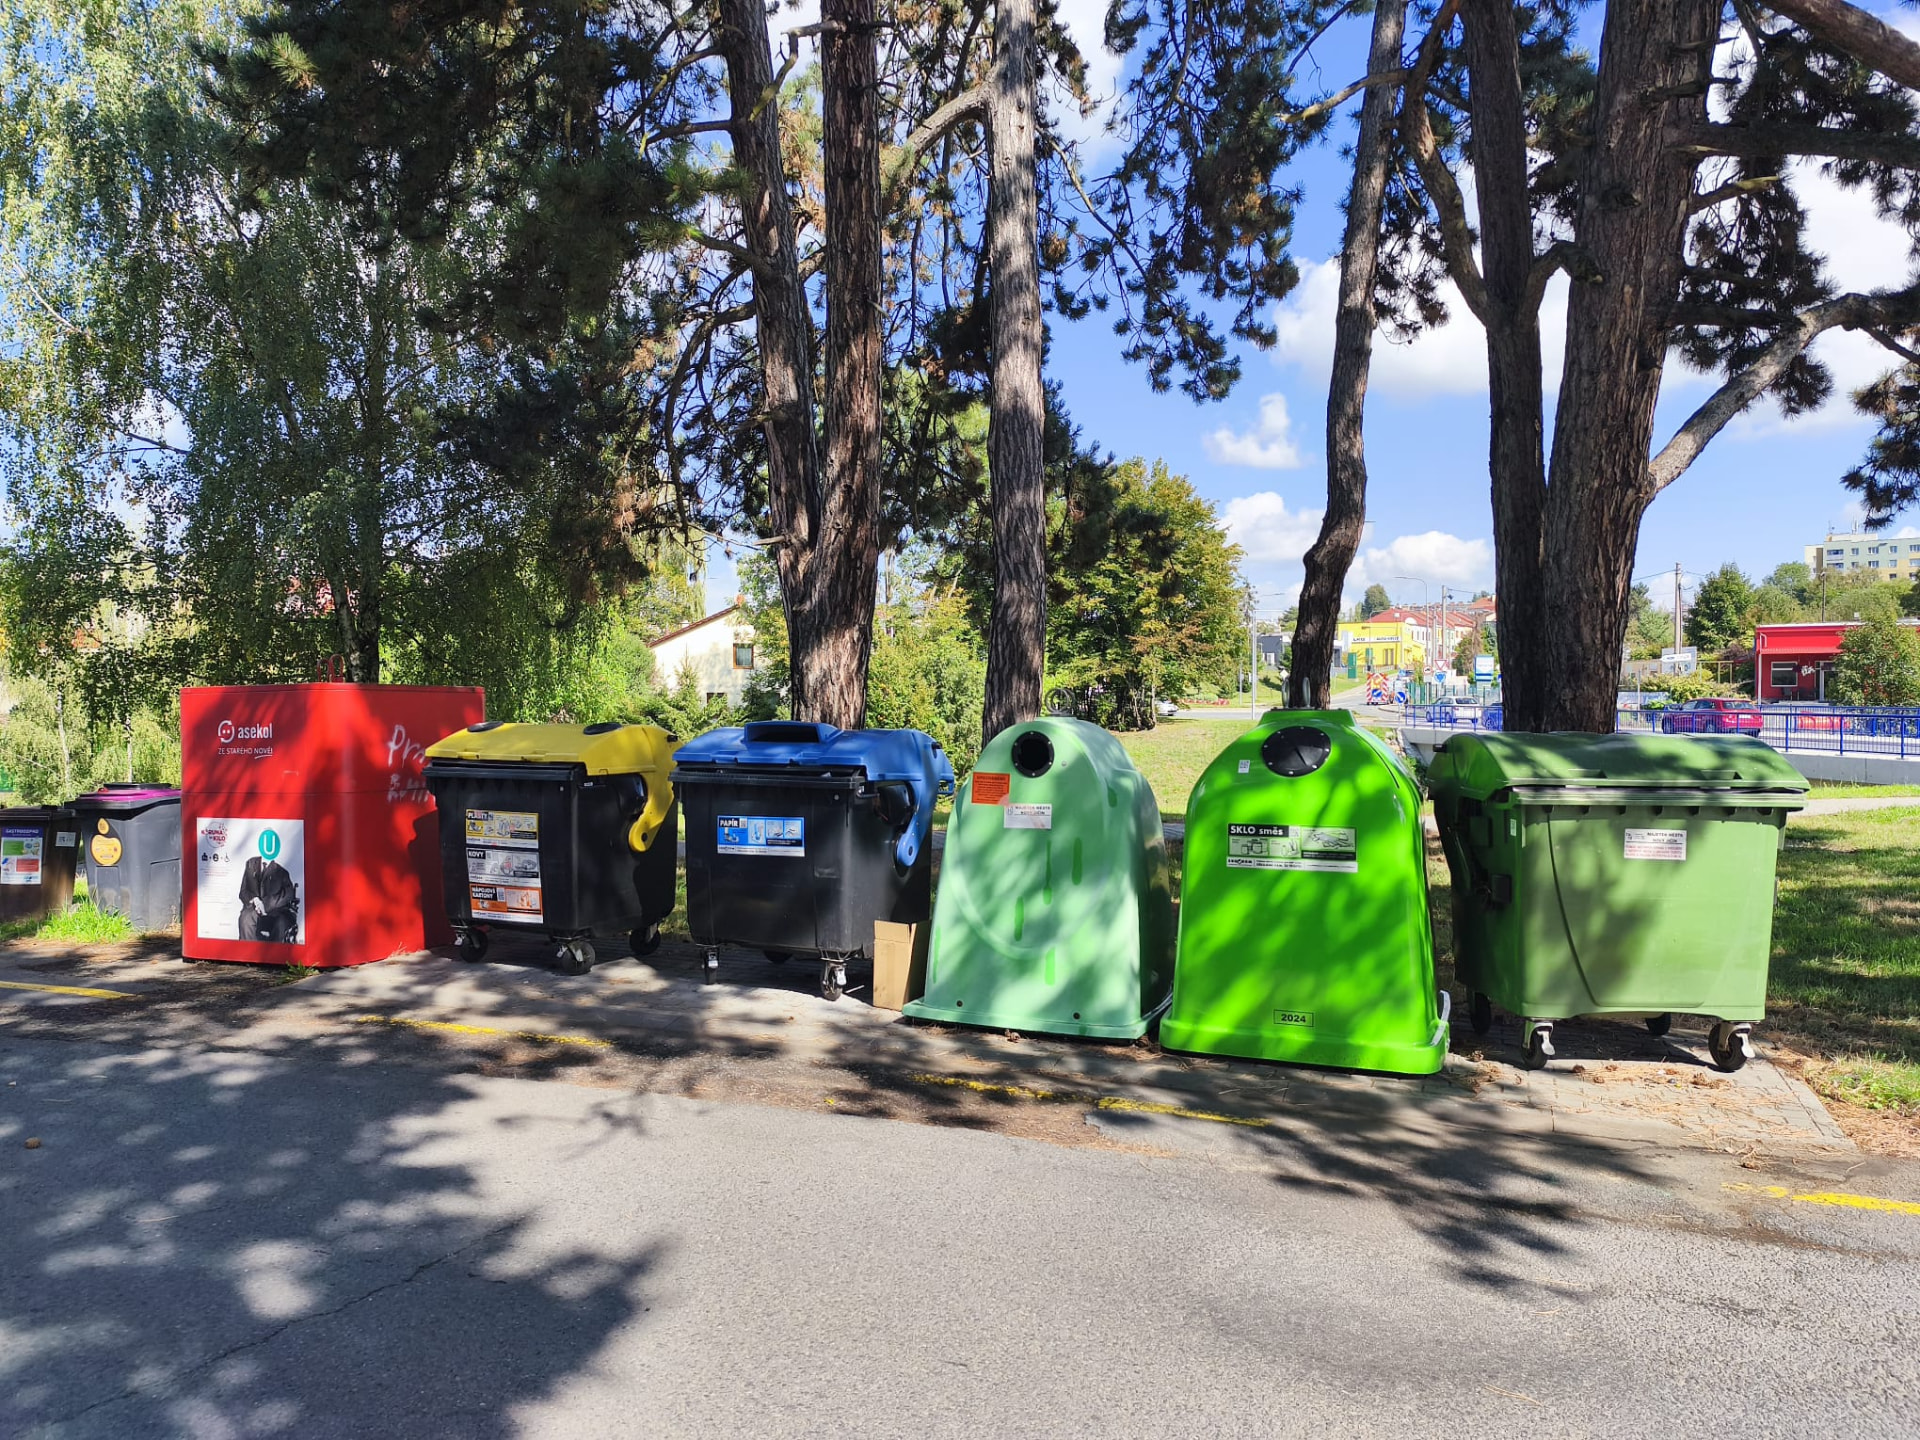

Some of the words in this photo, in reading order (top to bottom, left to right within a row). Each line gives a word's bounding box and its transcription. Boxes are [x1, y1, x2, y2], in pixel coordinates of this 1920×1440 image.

[237, 722, 273, 739] asekol
[218, 747, 225, 755] ZE
[720, 818, 738, 827] PAPÍR
[1230, 825, 1256, 834] SKLO
[1258, 827, 1284, 836] směs
[263, 834, 276, 855] U
[468, 851, 484, 859] KOVY
[1281, 1014, 1306, 1022] 2024
